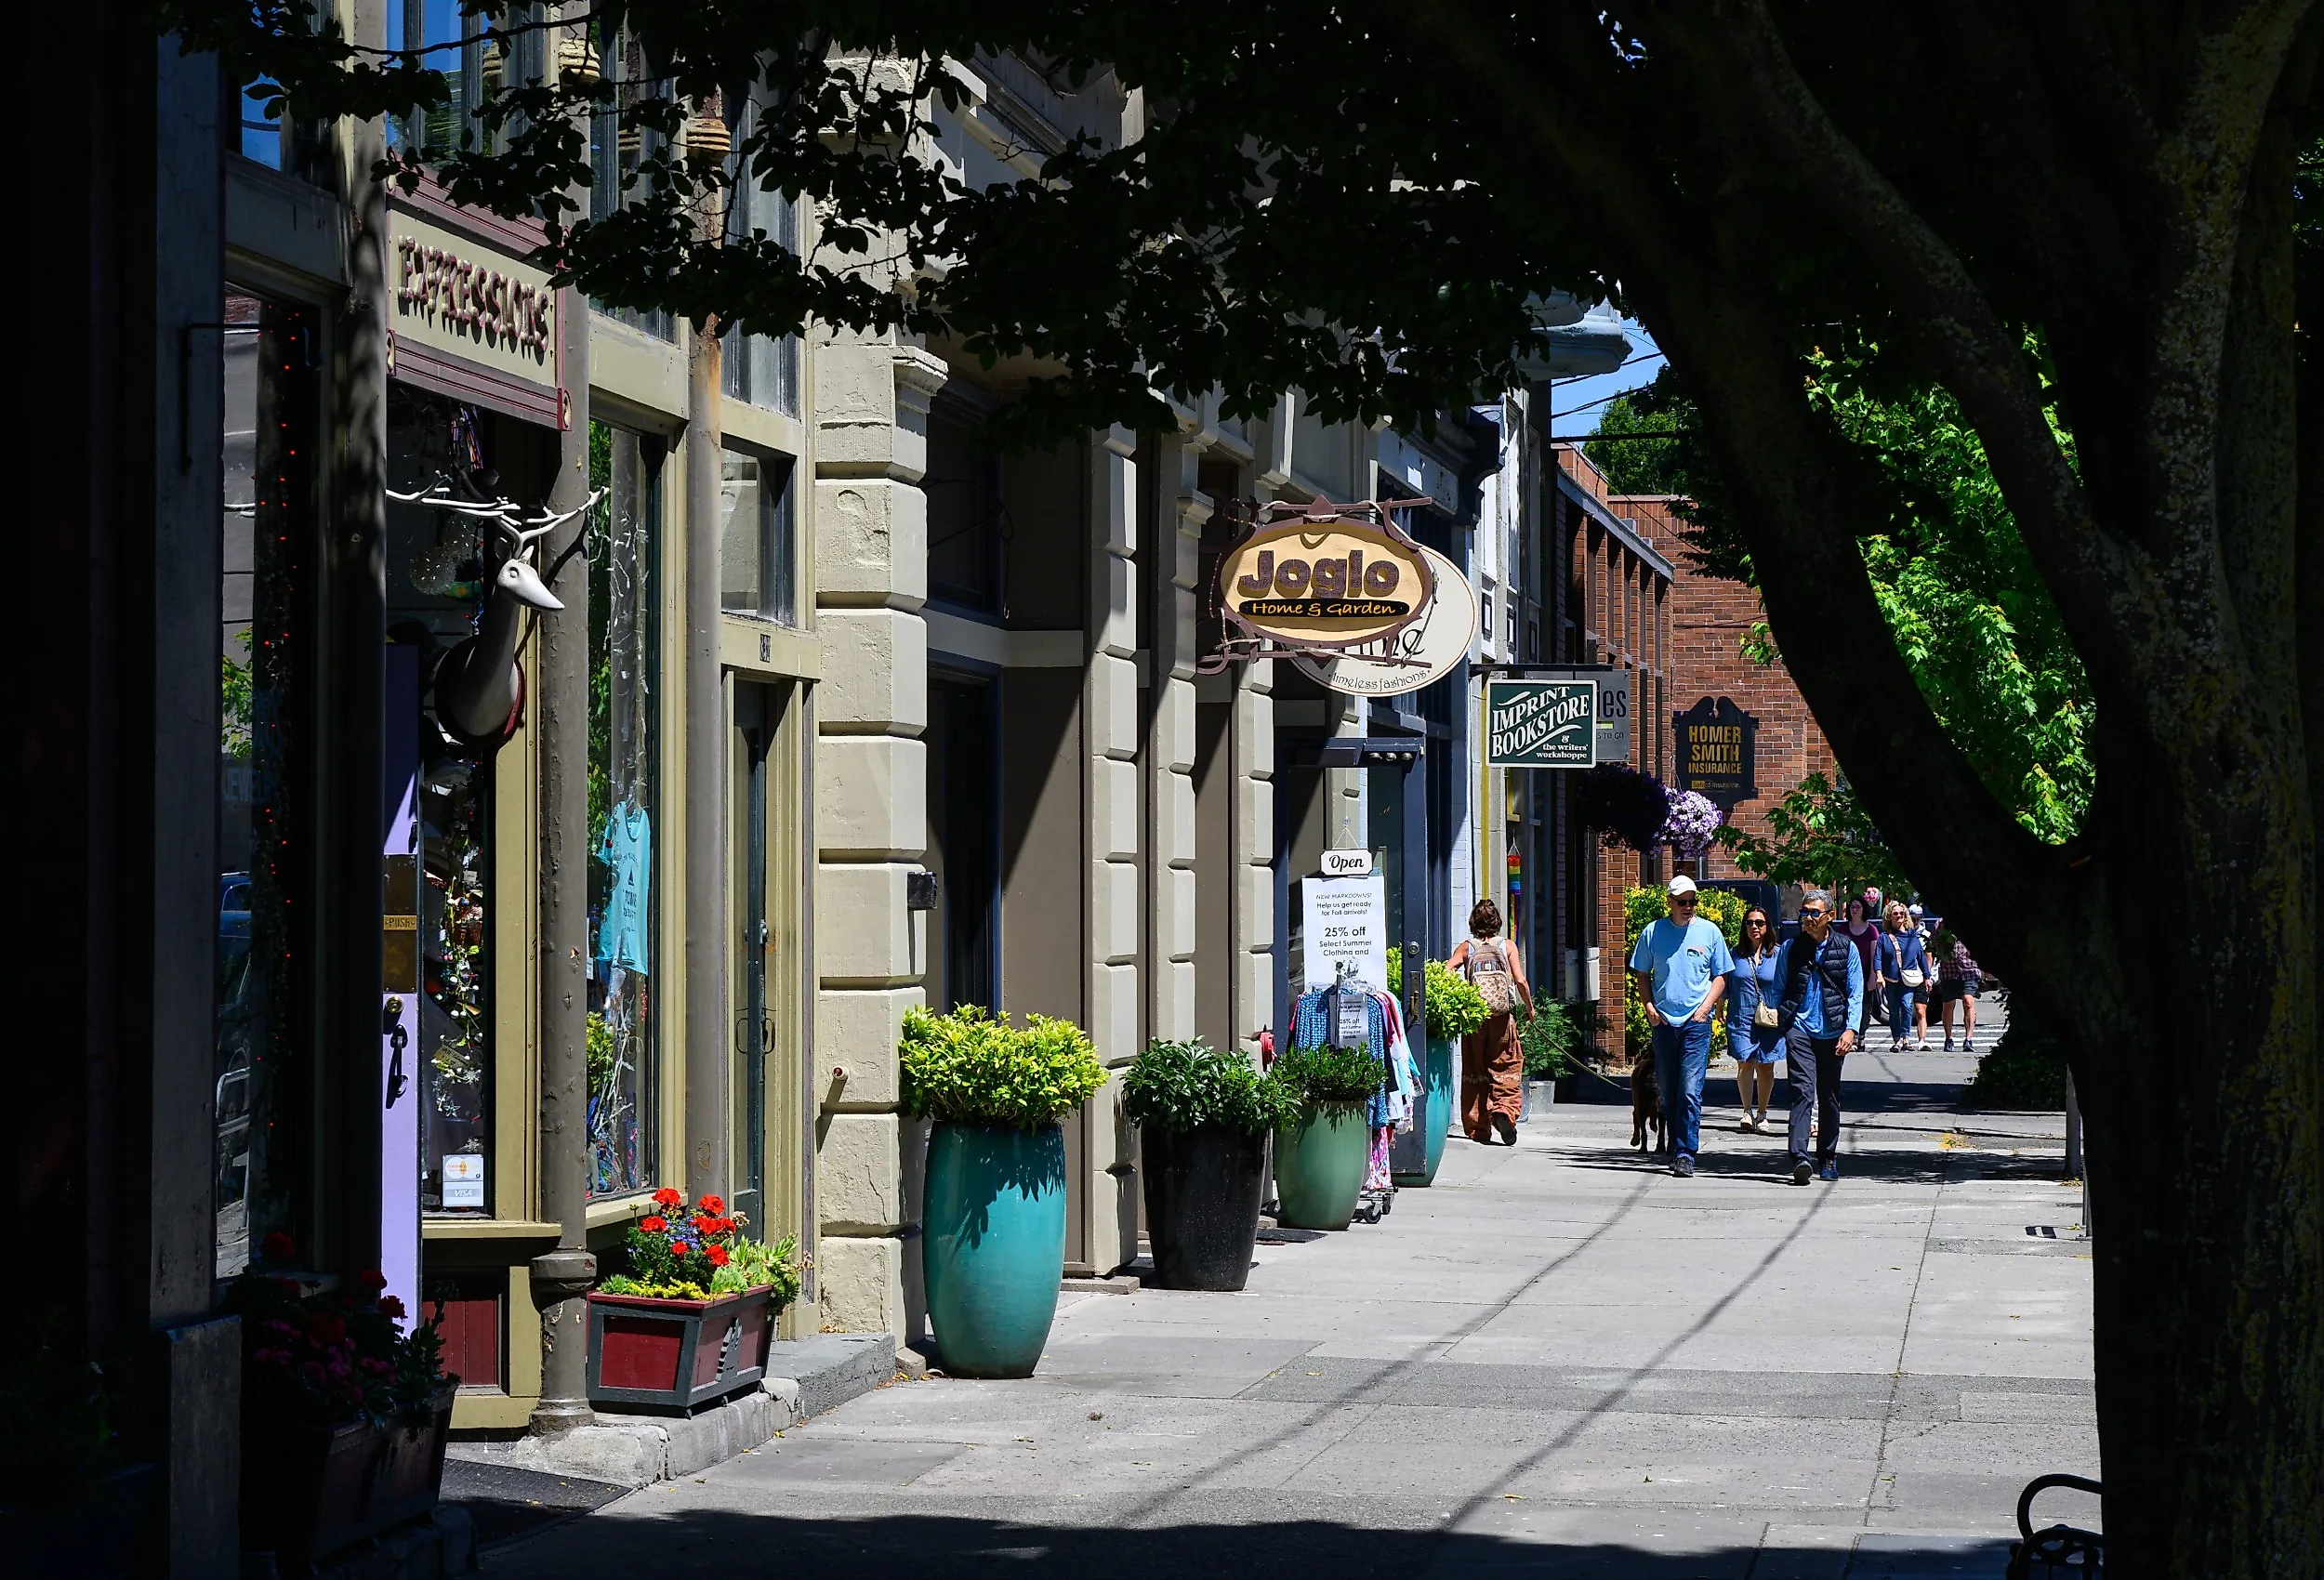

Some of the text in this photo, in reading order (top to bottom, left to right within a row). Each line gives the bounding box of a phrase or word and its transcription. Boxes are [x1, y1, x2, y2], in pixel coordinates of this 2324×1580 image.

[398, 235, 549, 353] EXPRESSIONS
[1238, 550, 1399, 598] Joglo
[1252, 602, 1396, 617] Home & Garden
[1332, 671, 1427, 692] timeless fashions
[1493, 686, 1569, 734] IMPRINT
[1492, 694, 1590, 757] BOOKSTORE
[1689, 725, 1741, 743] HOMER
[1543, 743, 1588, 751] the writers'
[1562, 734, 1569, 744] &
[1537, 751, 1588, 760] workshoppe
[1692, 744, 1739, 761] SMITH
[1688, 762, 1742, 773] INSURANCE
[1328, 854, 1365, 872] Open
[389, 917, 410, 928] PUSH
[1325, 926, 1367, 938] 25% off
